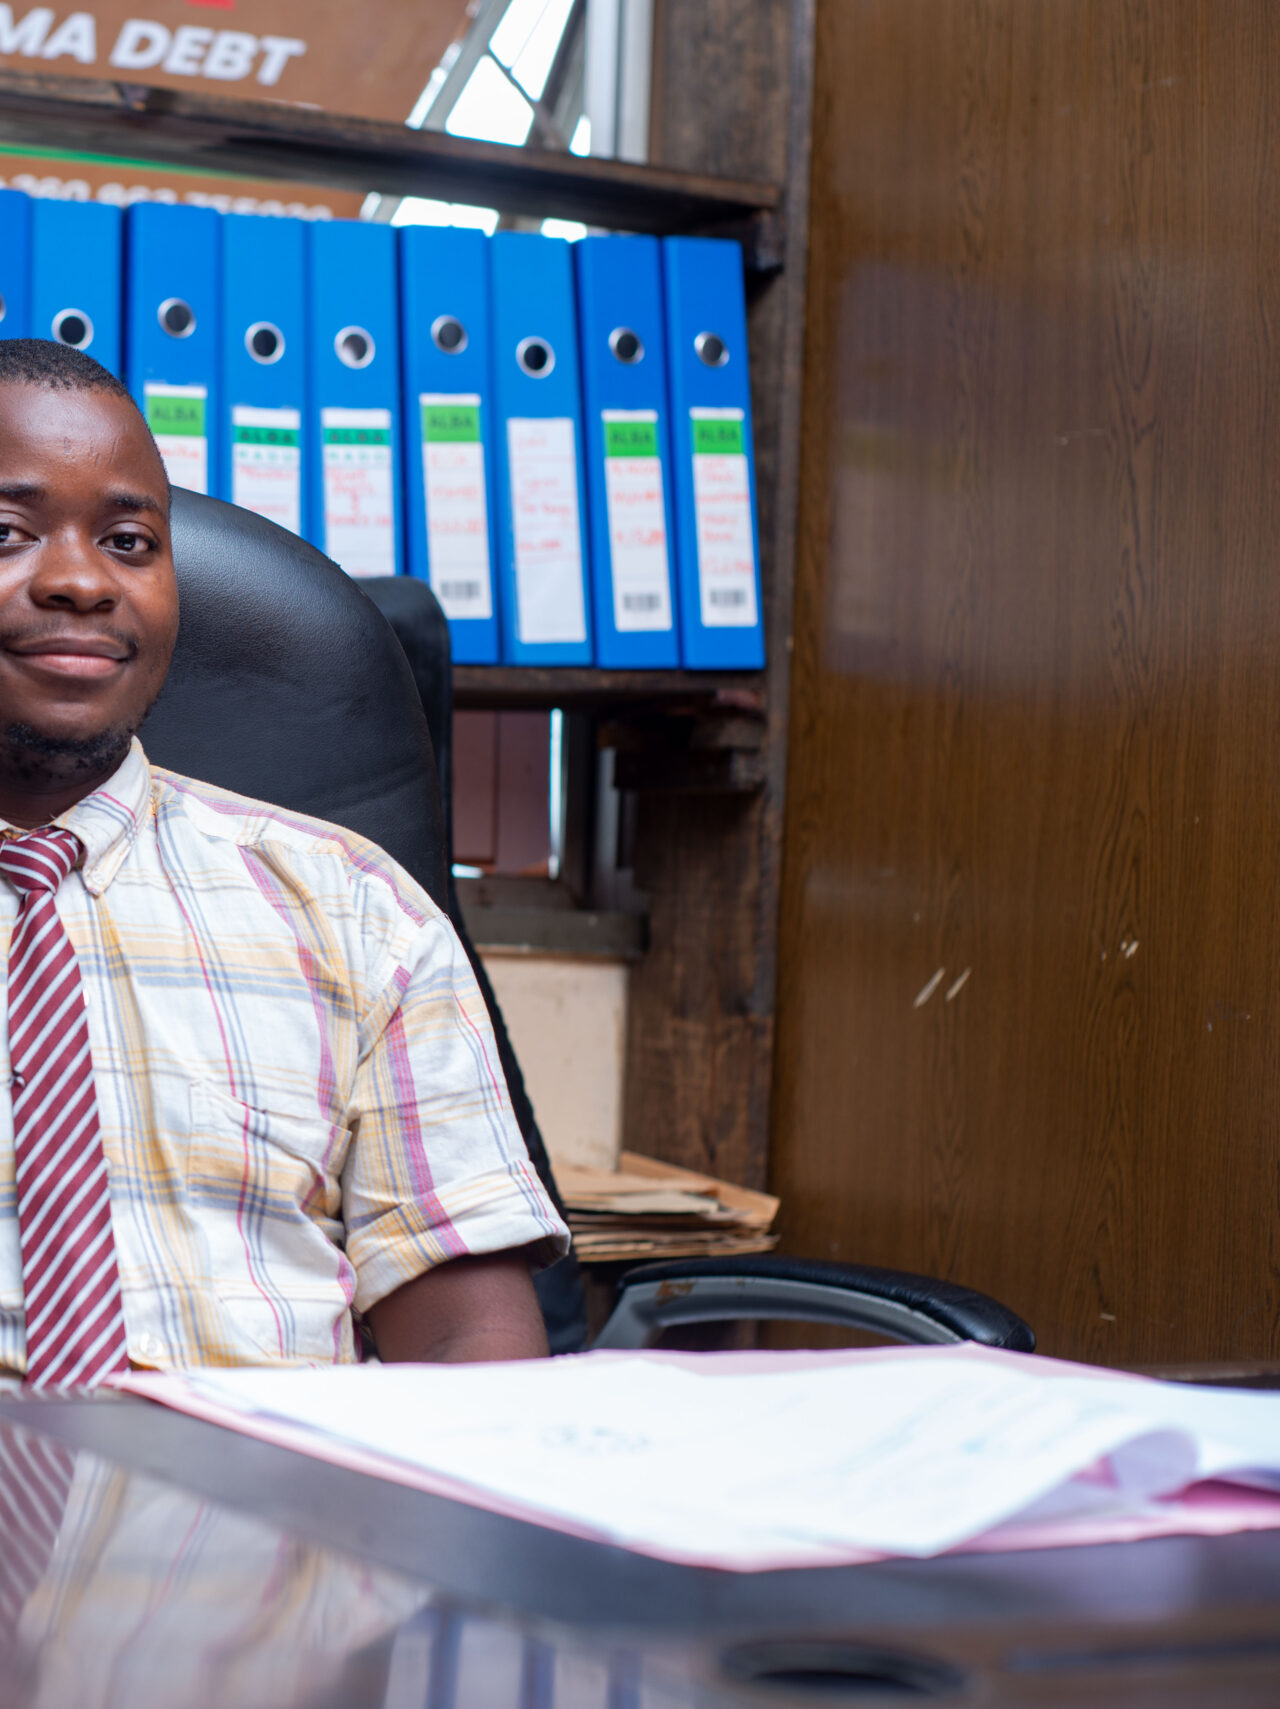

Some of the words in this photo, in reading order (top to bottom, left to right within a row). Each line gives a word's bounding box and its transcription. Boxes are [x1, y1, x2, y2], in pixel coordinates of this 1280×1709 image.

[109, 18, 306, 86] DEBT
[153, 406, 198, 422] ALBA
[429, 413, 473, 431] ALBA
[612, 428, 652, 444] ALBA
[700, 426, 738, 442] ALBA
